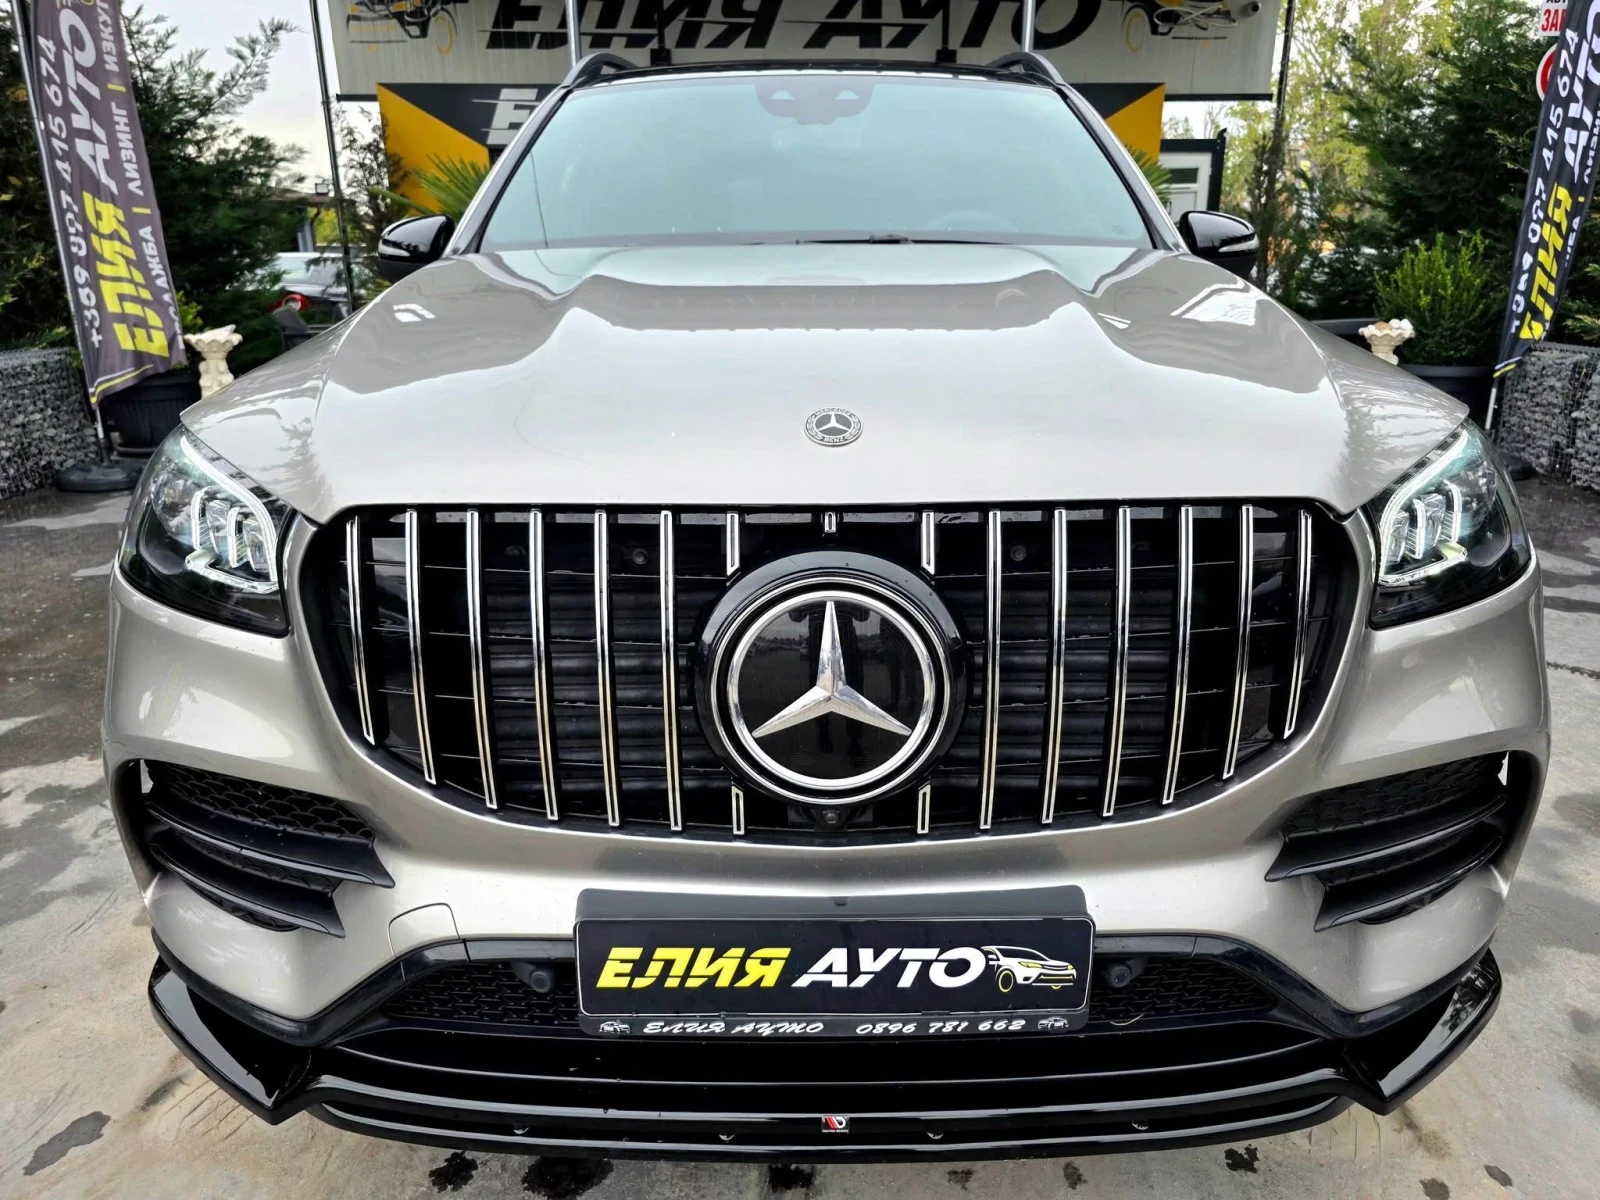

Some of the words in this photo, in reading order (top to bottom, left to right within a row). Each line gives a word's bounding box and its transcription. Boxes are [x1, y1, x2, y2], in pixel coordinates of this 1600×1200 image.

[37, 35, 63, 107] 674
[59, 8, 118, 196] АУТО
[1542, 104, 1563, 171] 415
[1557, 28, 1578, 98] 674
[48, 117, 70, 179] 415
[110, 101, 144, 197] ЛИЗИНГ
[83, 190, 169, 358] ЕЛИЯ
[596, 947, 791, 988] ЕЛИЯ
[791, 947, 986, 988] АУТО
[643, 1021, 726, 1034] ЕЛИЯ
[856, 1022, 917, 1034] 0896
[928, 1021, 969, 1033] 781
[977, 1019, 1026, 1031] 662
